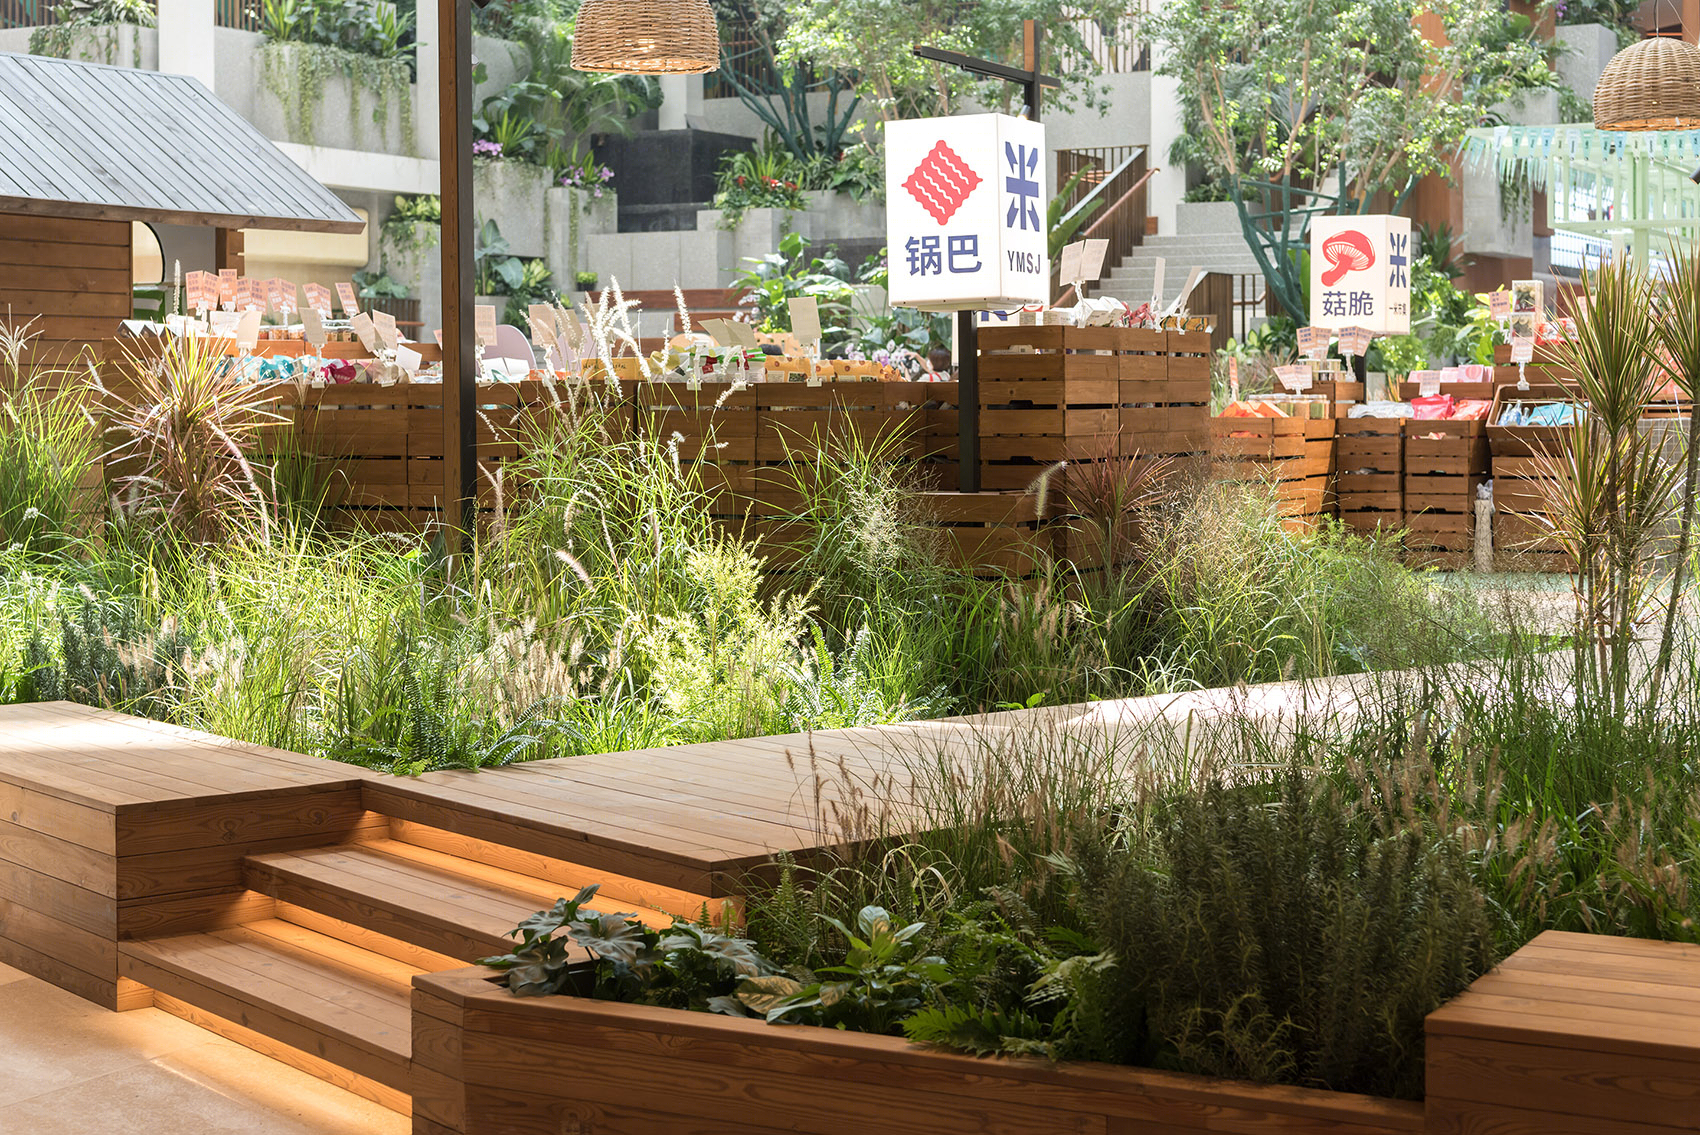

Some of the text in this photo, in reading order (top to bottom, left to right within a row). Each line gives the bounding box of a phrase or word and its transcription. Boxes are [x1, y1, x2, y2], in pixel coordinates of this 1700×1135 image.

[1005, 141, 1040, 232] 米
[904, 234, 982, 276] 锅巴
[1007, 249, 1041, 275] YMSJ
[1389, 232, 1407, 288] 米
[1322, 290, 1374, 317] 菇脆
